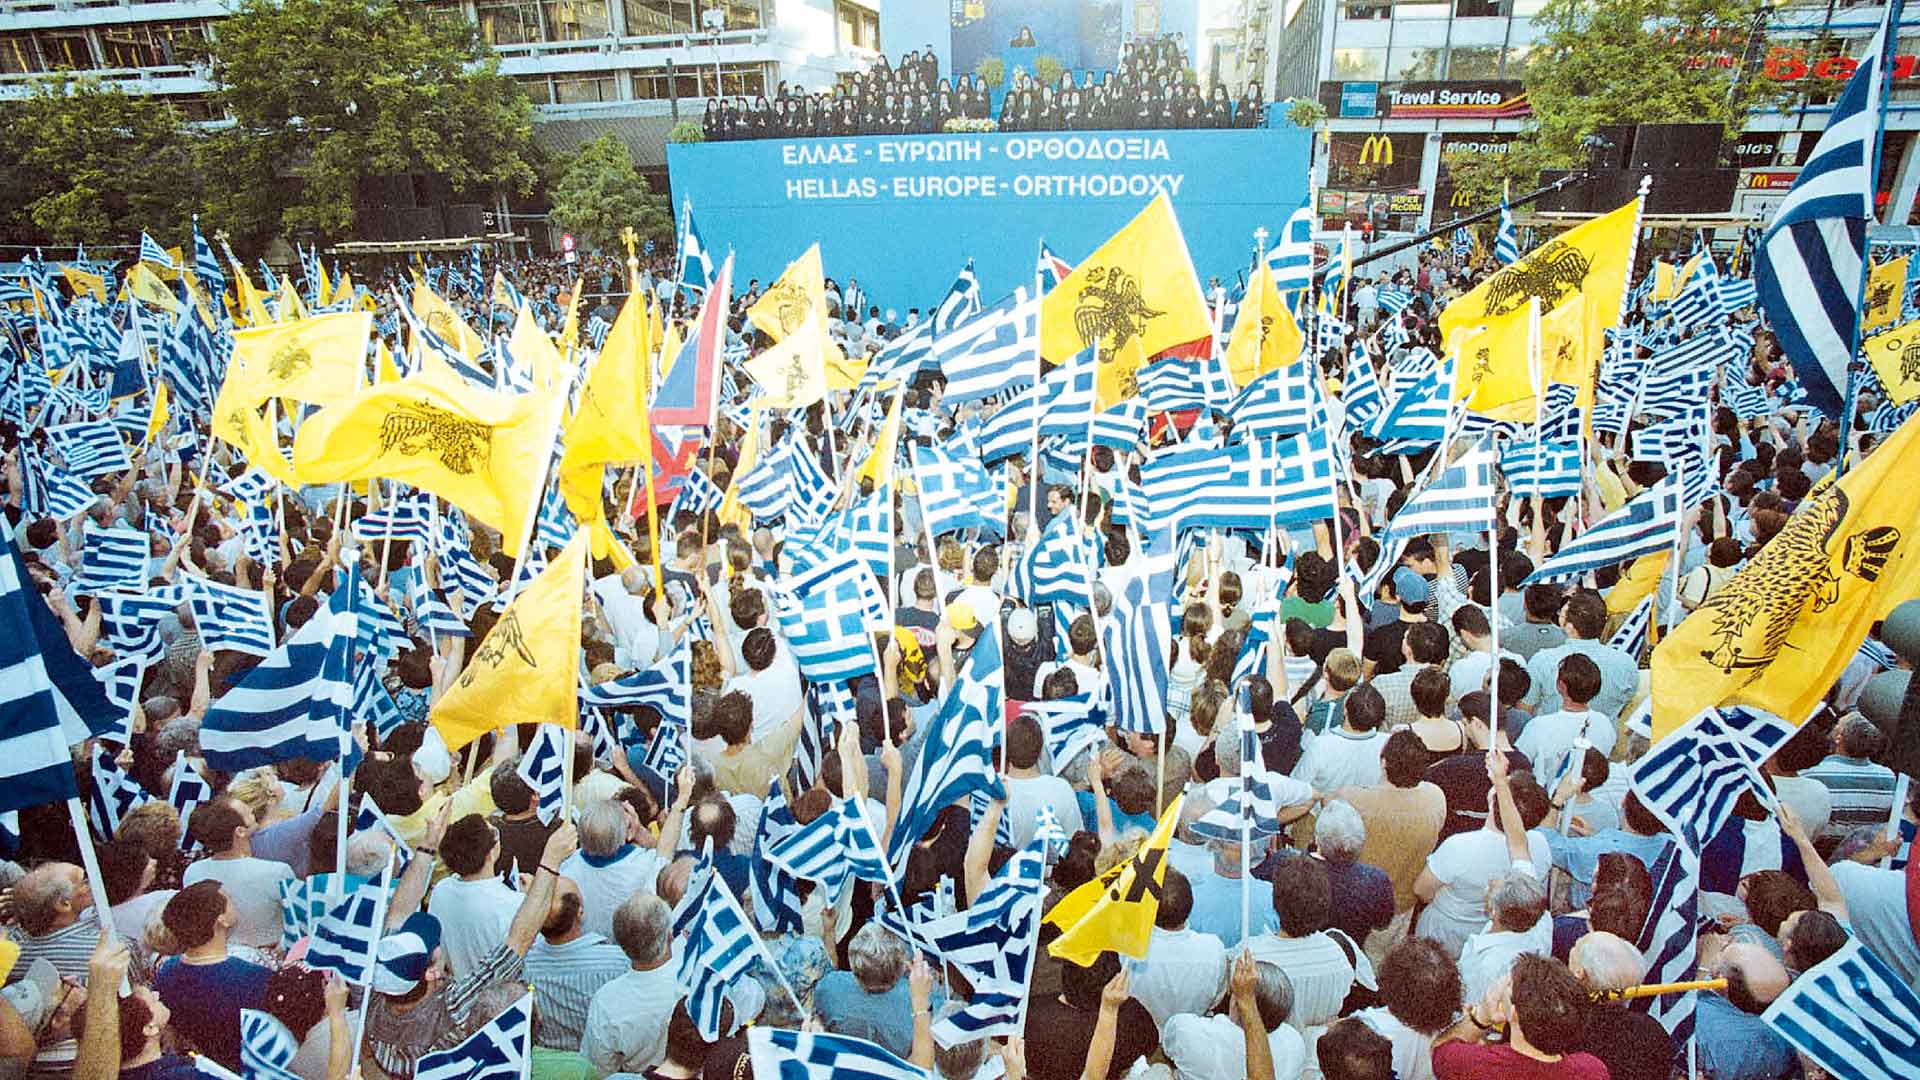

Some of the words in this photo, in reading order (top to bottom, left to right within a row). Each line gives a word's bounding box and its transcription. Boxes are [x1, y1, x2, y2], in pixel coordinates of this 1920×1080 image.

[1389, 89, 1435, 105] Travel
[1439, 89, 1501, 105] Service
[782, 143, 858, 165] ΕΛΛΑΣ
[879, 140, 982, 163] ΕΥΡΩΠΗ
[1005, 138, 1170, 161] ΟΡΘΟΔΟΞΙΑ
[1446, 142, 1512, 154] McDonal
[786, 177, 878, 200] HELLAS
[893, 175, 996, 197] EUROPE
[1013, 174, 1184, 197] ORTHODOXY
